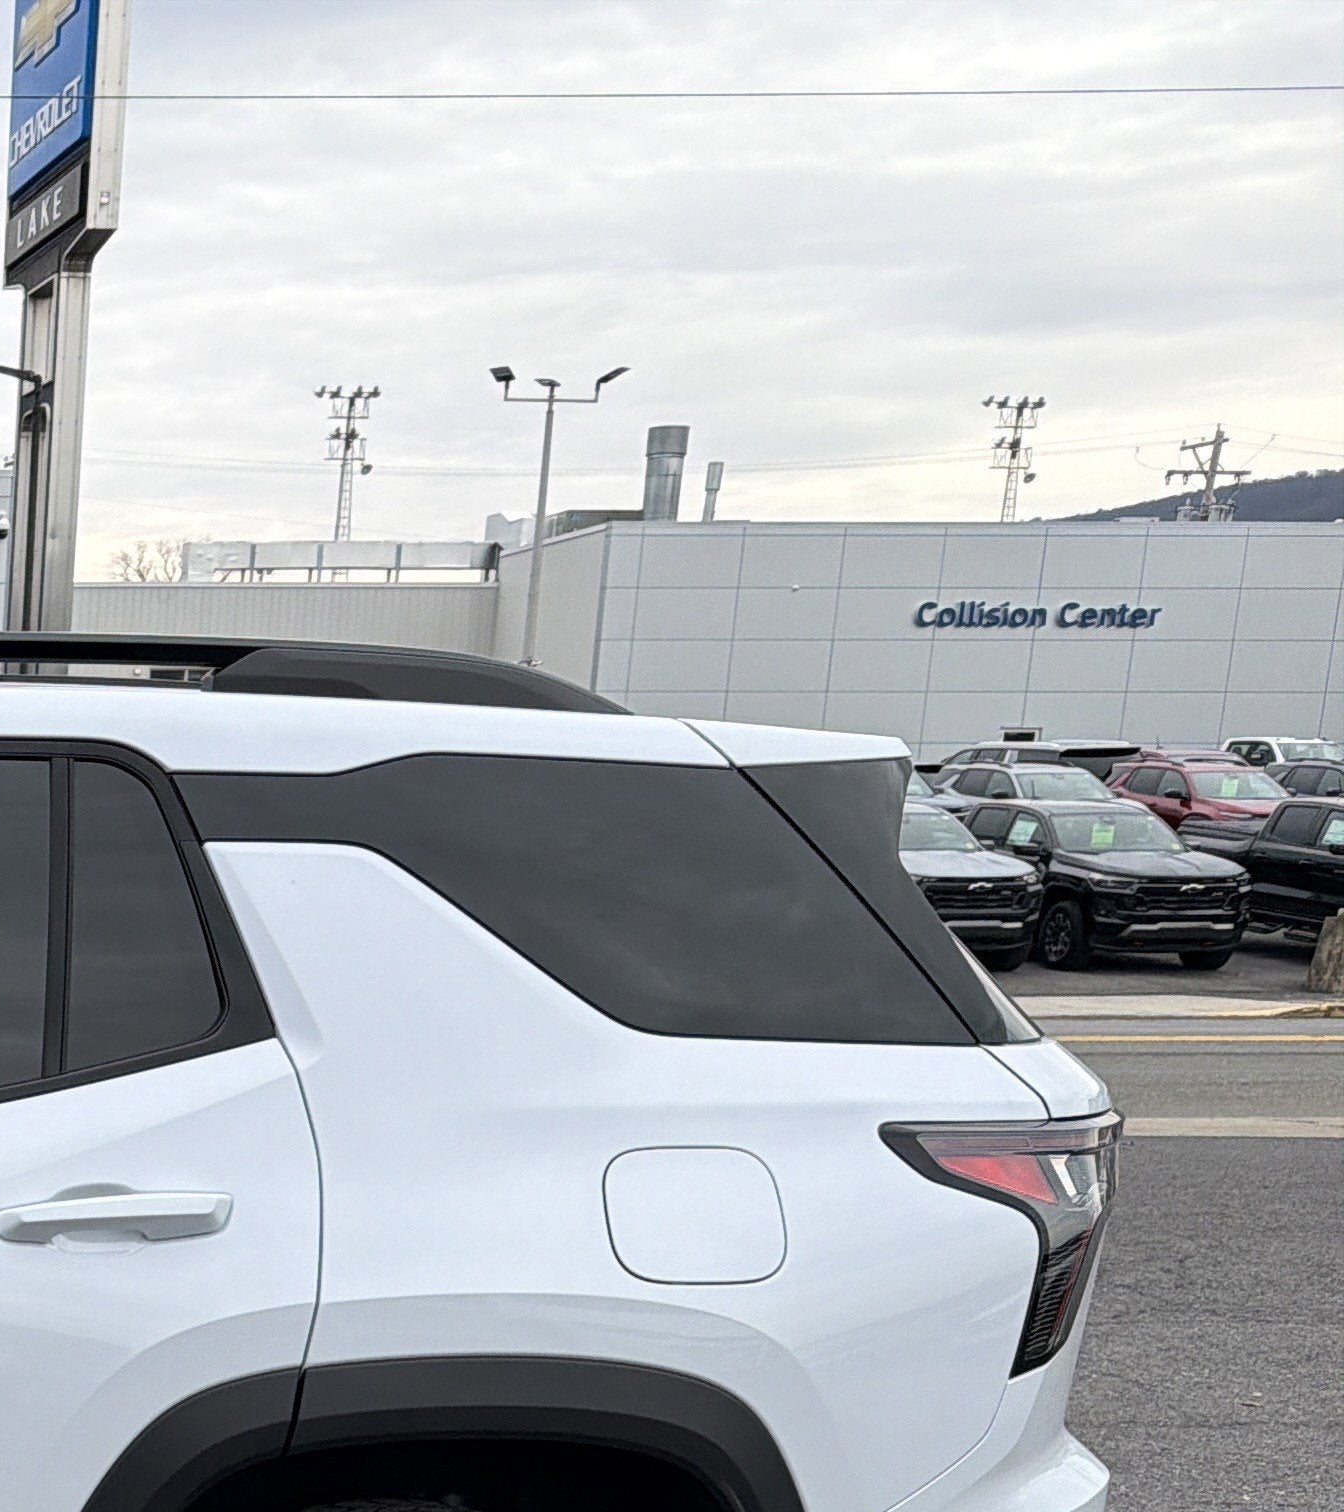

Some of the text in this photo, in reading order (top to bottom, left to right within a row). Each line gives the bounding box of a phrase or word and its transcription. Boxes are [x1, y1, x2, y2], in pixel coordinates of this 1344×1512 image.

[10, 74, 81, 166] CHEVROLET
[16, 186, 63, 248] LAKE
[914, 600, 1163, 629] Collision Center
